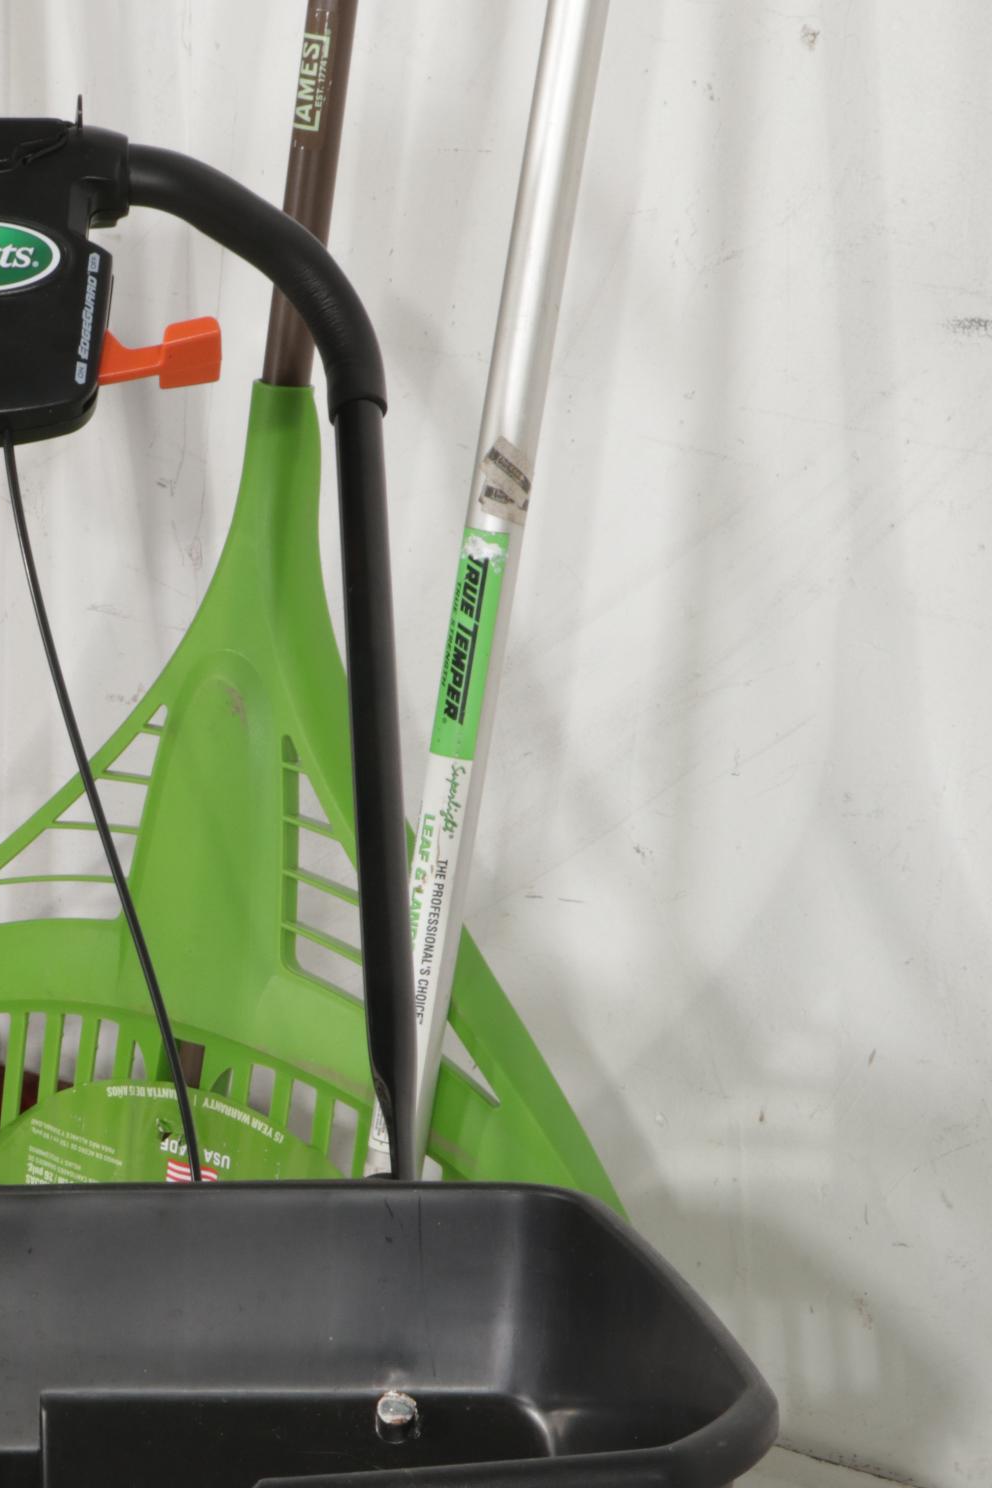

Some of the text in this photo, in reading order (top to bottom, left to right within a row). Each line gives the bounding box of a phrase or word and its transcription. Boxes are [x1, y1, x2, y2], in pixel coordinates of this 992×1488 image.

[295, 41, 320, 122] AMES
[315, 60, 328, 107] EST. 1774
[443, 555, 489, 726] TRUE TEMPER
[418, 813, 436, 862] LEAF
[435, 859, 448, 879] THE
[419, 882, 445, 977] PROFESSIONAL'S
[202, 1098, 250, 1125] WARRANTY
[250, 1116, 273, 1138] YEAR
[203, 1149, 231, 1170] USA
